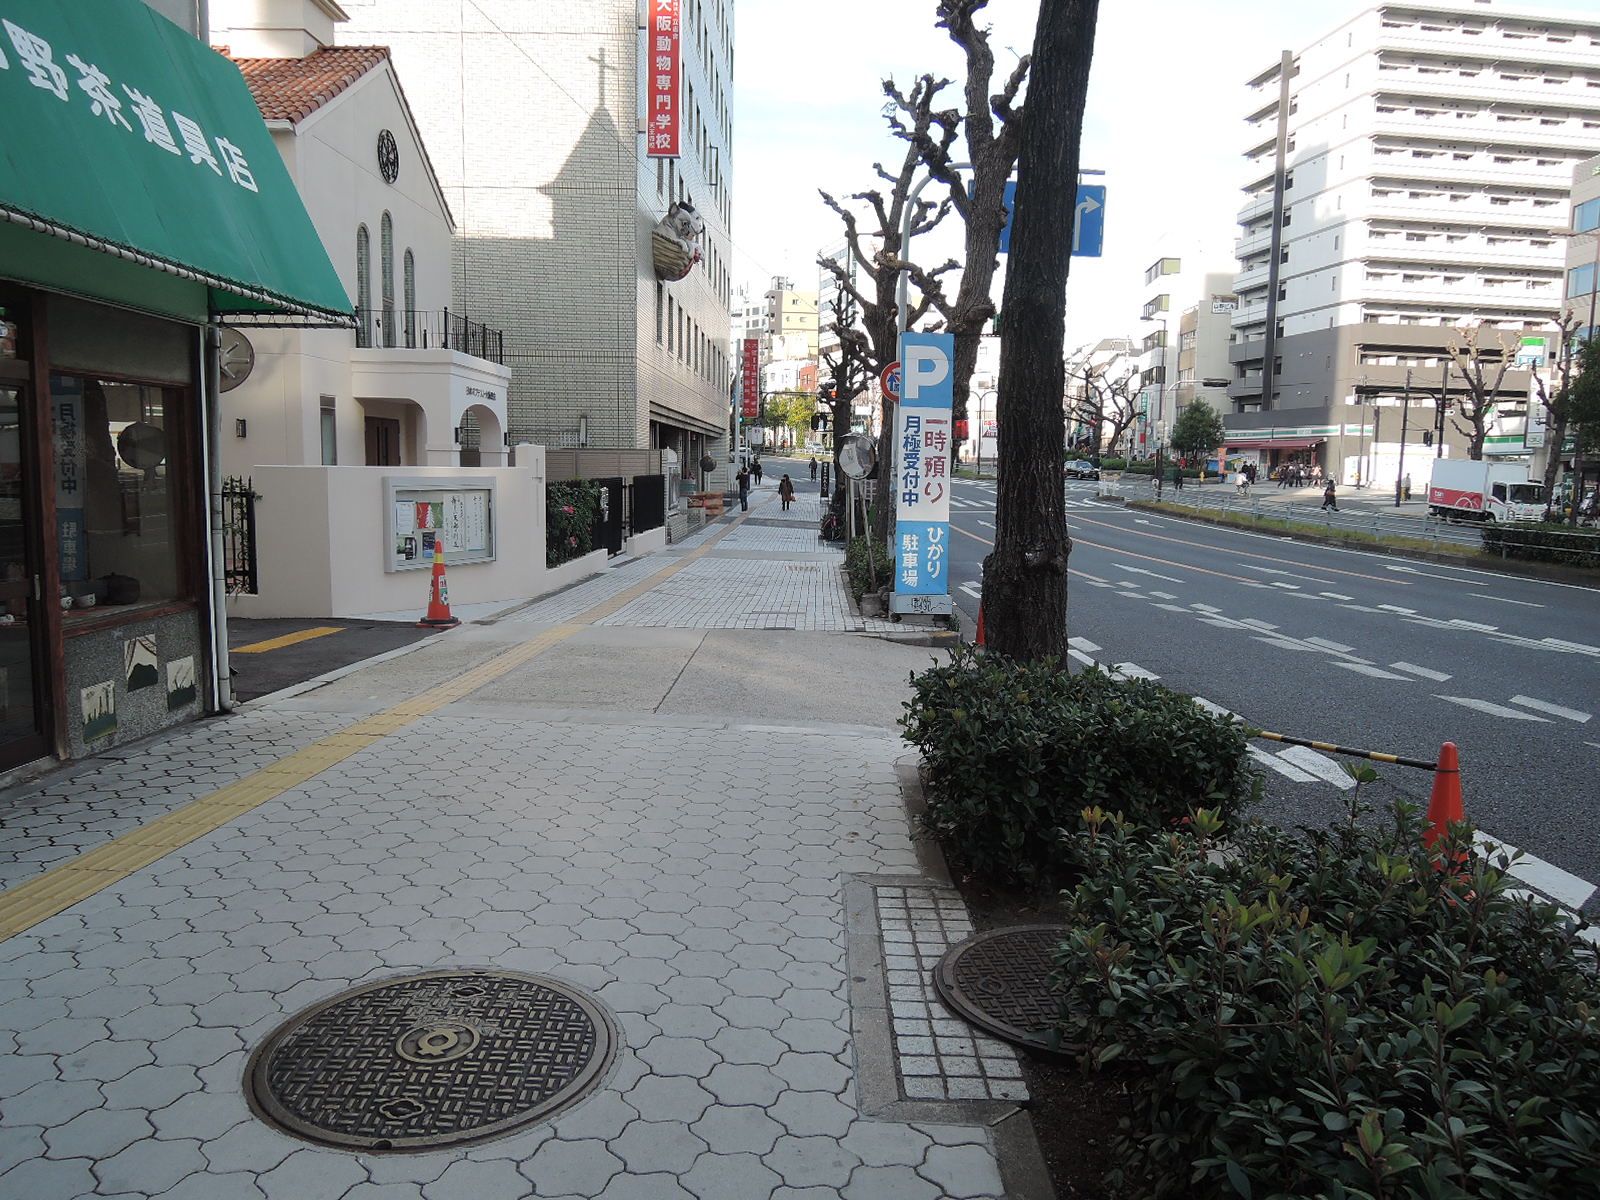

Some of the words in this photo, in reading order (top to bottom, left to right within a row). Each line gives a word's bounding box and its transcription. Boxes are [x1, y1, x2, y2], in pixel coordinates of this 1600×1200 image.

[0, 18, 259, 193] 野茶道具店
[656, 0, 671, 149] 大阪動物専門学校
[905, 345, 949, 399] P
[902, 415, 921, 507] 月極受付中
[924, 418, 948, 504] 一時預り
[902, 534, 919, 588] 駐車場
[927, 527, 944, 579] ひかり
